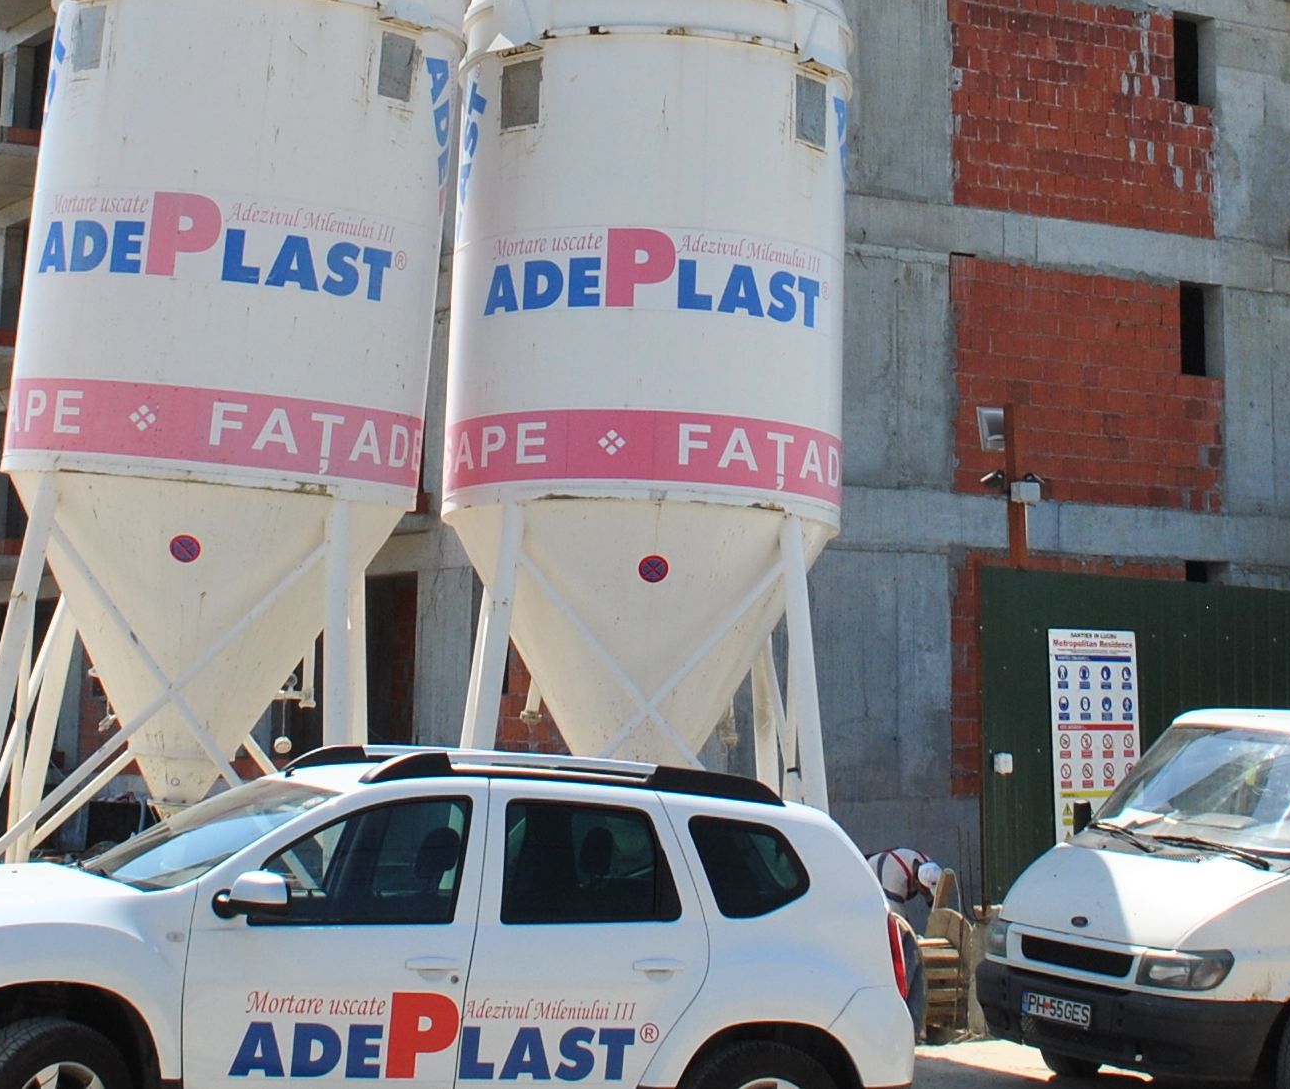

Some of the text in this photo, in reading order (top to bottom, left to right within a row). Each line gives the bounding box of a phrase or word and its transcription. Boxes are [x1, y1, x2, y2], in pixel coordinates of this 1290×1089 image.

[50, 193, 150, 216] Mortare uscate
[225, 202, 395, 244] Adezivul Mileniului III
[38, 191, 393, 302] ADEPLAST
[492, 232, 603, 261] Mortare uscate
[676, 234, 822, 274] Adezivul Mileniului III
[484, 228, 820, 329] ADEPLAST
[447, 421, 548, 474] APE
[1052, 639, 1133, 648] Metropolitan Residence
[245, 991, 387, 1016] Mortare uscate
[464, 998, 637, 1021] Adezivul Mileniului III
[228, 992, 636, 1080] ADEPLAST
